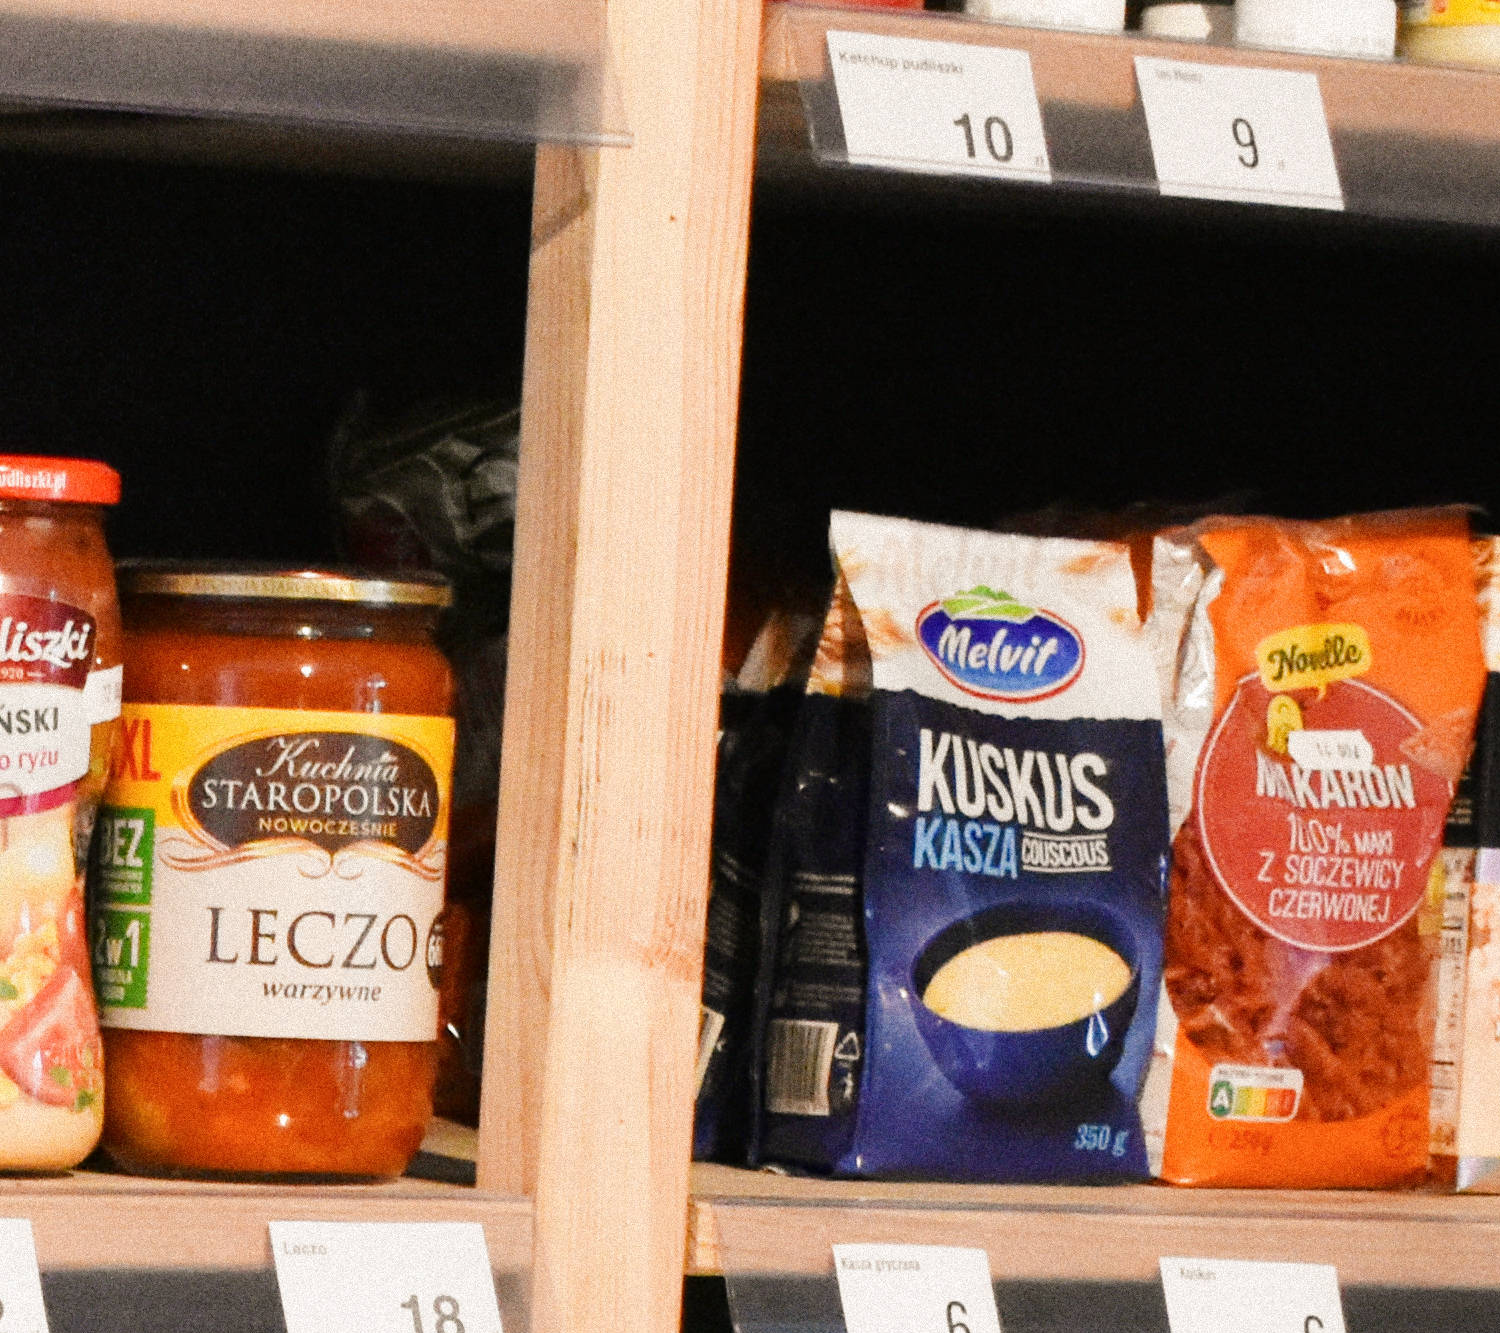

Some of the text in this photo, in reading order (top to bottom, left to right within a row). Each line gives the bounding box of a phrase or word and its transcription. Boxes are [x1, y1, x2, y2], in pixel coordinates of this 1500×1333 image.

[953, 112, 1014, 163] 10
[1230, 117, 1259, 168] 9
[937, 622, 1060, 678] Melvit
[16, 746, 60, 777] ryżu
[255, 735, 401, 783] Kuchnia
[918, 728, 1115, 832] KUSKUS
[202, 777, 432, 819] STAROPOLSKA
[258, 813, 398, 839] NOWOCZEŚNIE
[913, 817, 1110, 880] KASZA COUSCOUS
[1257, 850, 1405, 889] Z SOCZEWICY
[1268, 888, 1391, 923] CZERWONEJ
[205, 905, 419, 971] LECZO
[262, 979, 383, 1004] warzywne
[1073, 1122, 1111, 1152] 350
